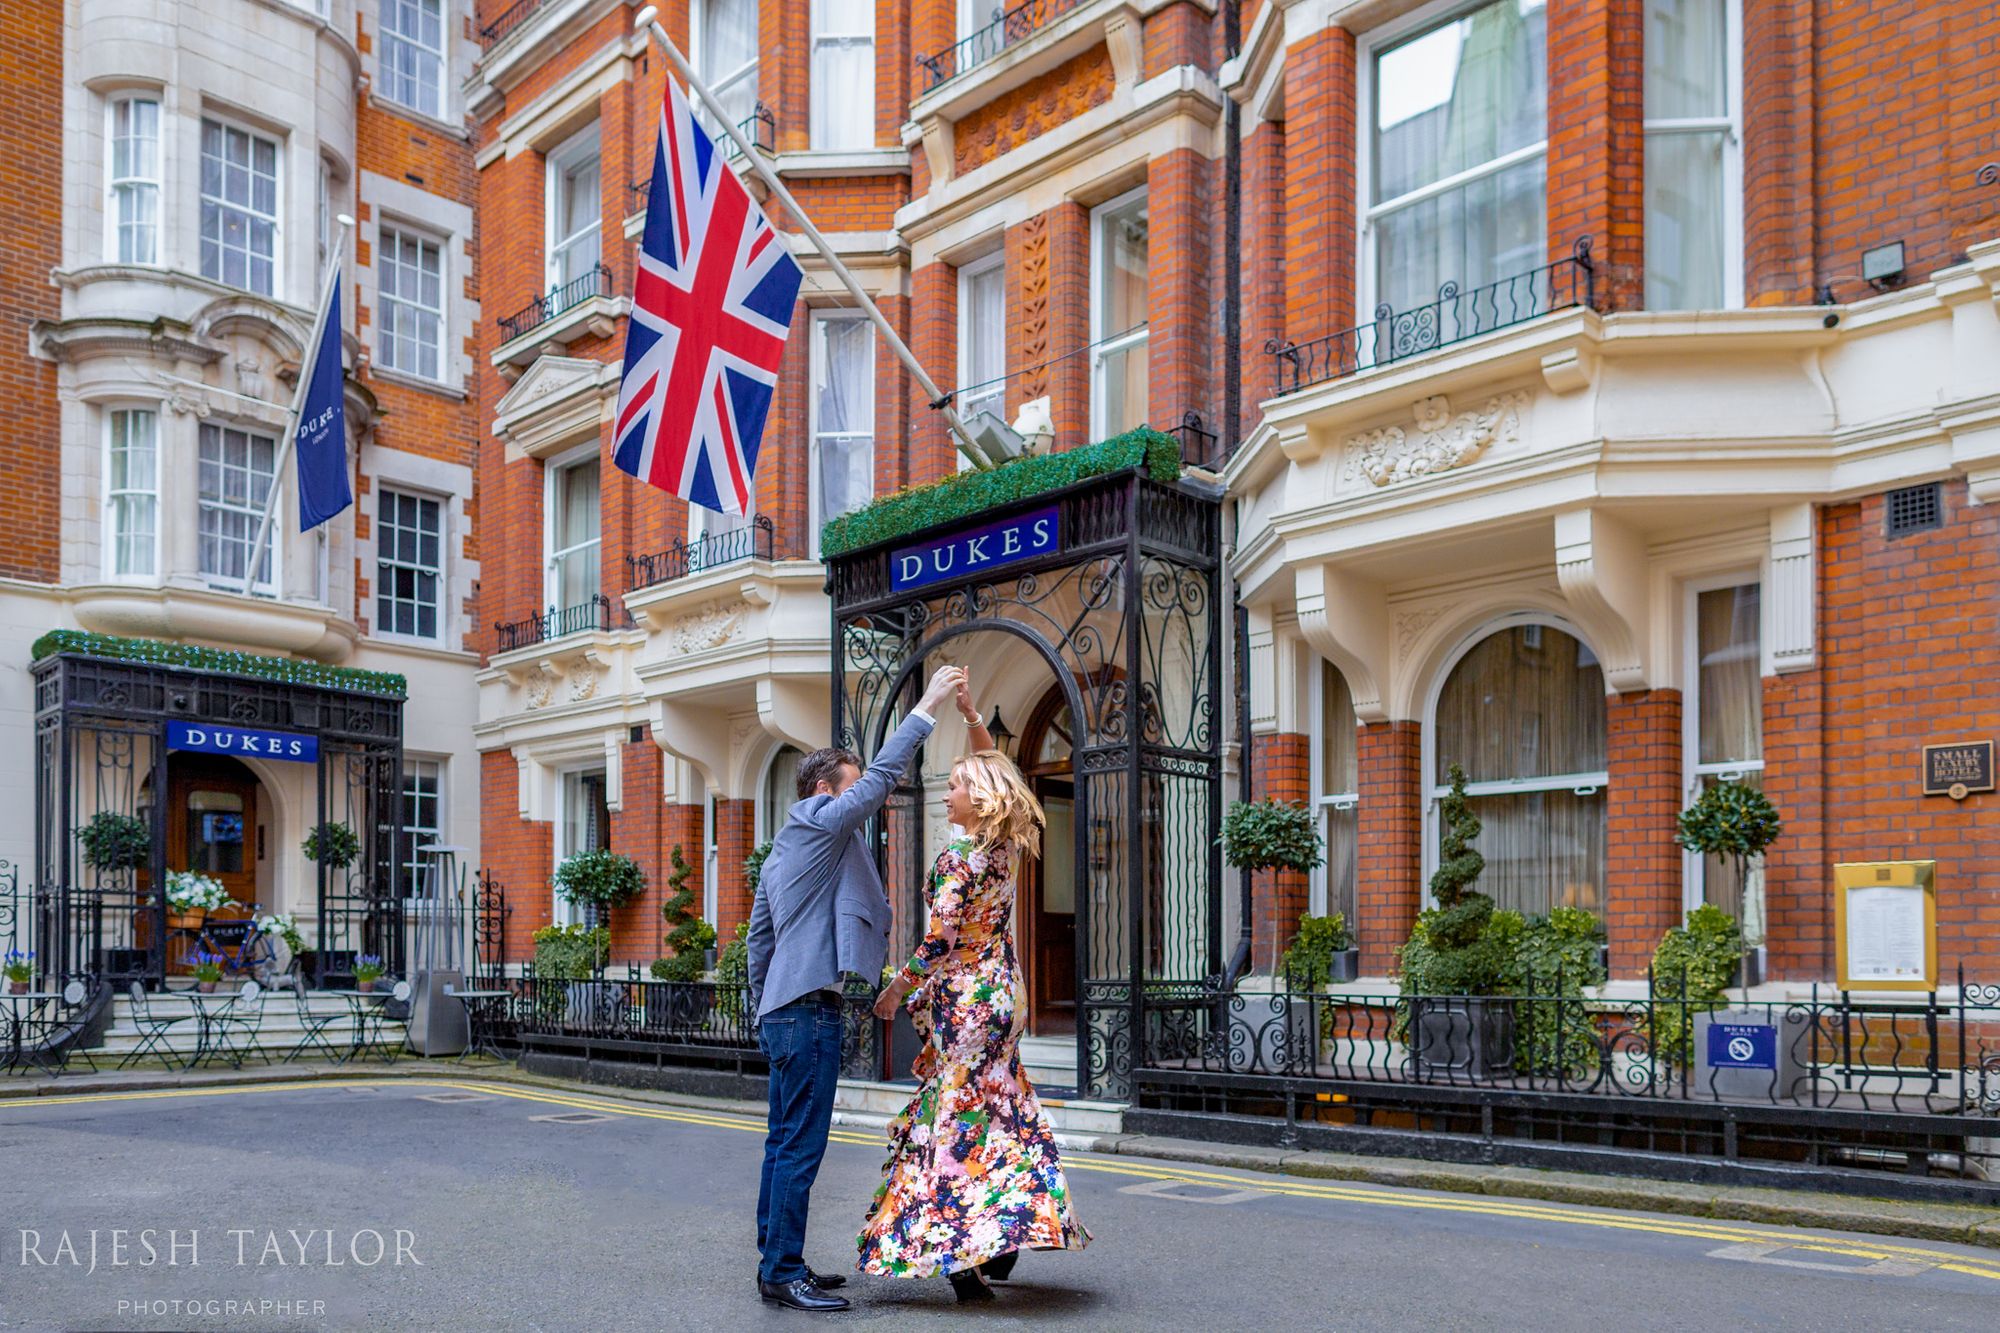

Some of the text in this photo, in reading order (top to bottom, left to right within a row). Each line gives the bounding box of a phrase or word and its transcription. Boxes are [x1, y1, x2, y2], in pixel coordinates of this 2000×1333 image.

[300, 406, 341, 439] DUKE
[899, 519, 1049, 582] DUKES
[185, 729, 303, 756] DUKES
[1933, 748, 1981, 760] SMALL
[1934, 758, 1979, 769] LUXURY
[1934, 767, 1982, 778] HOTELS
